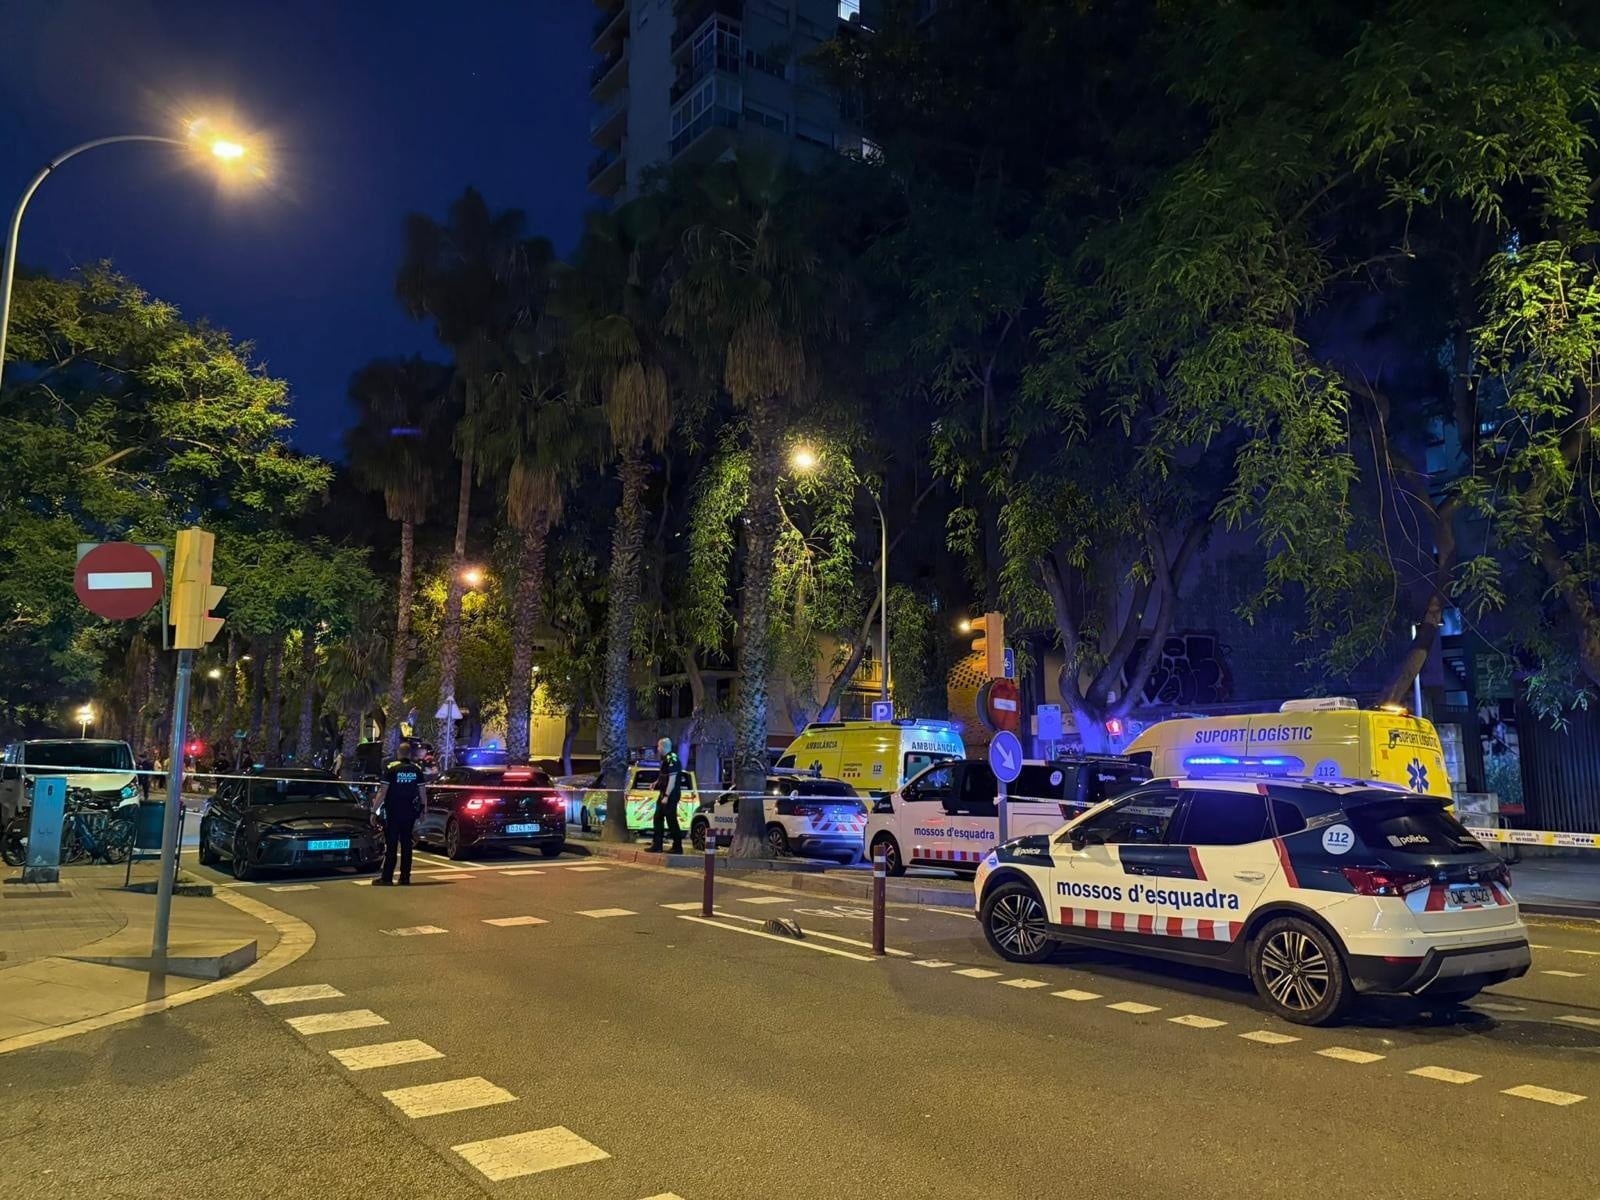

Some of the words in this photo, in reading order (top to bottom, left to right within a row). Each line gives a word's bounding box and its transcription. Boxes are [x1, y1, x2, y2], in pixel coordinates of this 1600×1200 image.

[876, 704, 888, 720] P
[1194, 728, 1247, 744] SUPORT
[1249, 724, 1313, 742] LOGÍSTIC
[1318, 766, 1336, 777] 112
[913, 827, 945, 837] mossos
[946, 826, 995, 840] d'esquadra
[1327, 831, 1349, 844] 112
[1400, 834, 1430, 847] policia
[1056, 881, 1122, 901] mossos
[1128, 884, 1240, 910] d'esquadra
